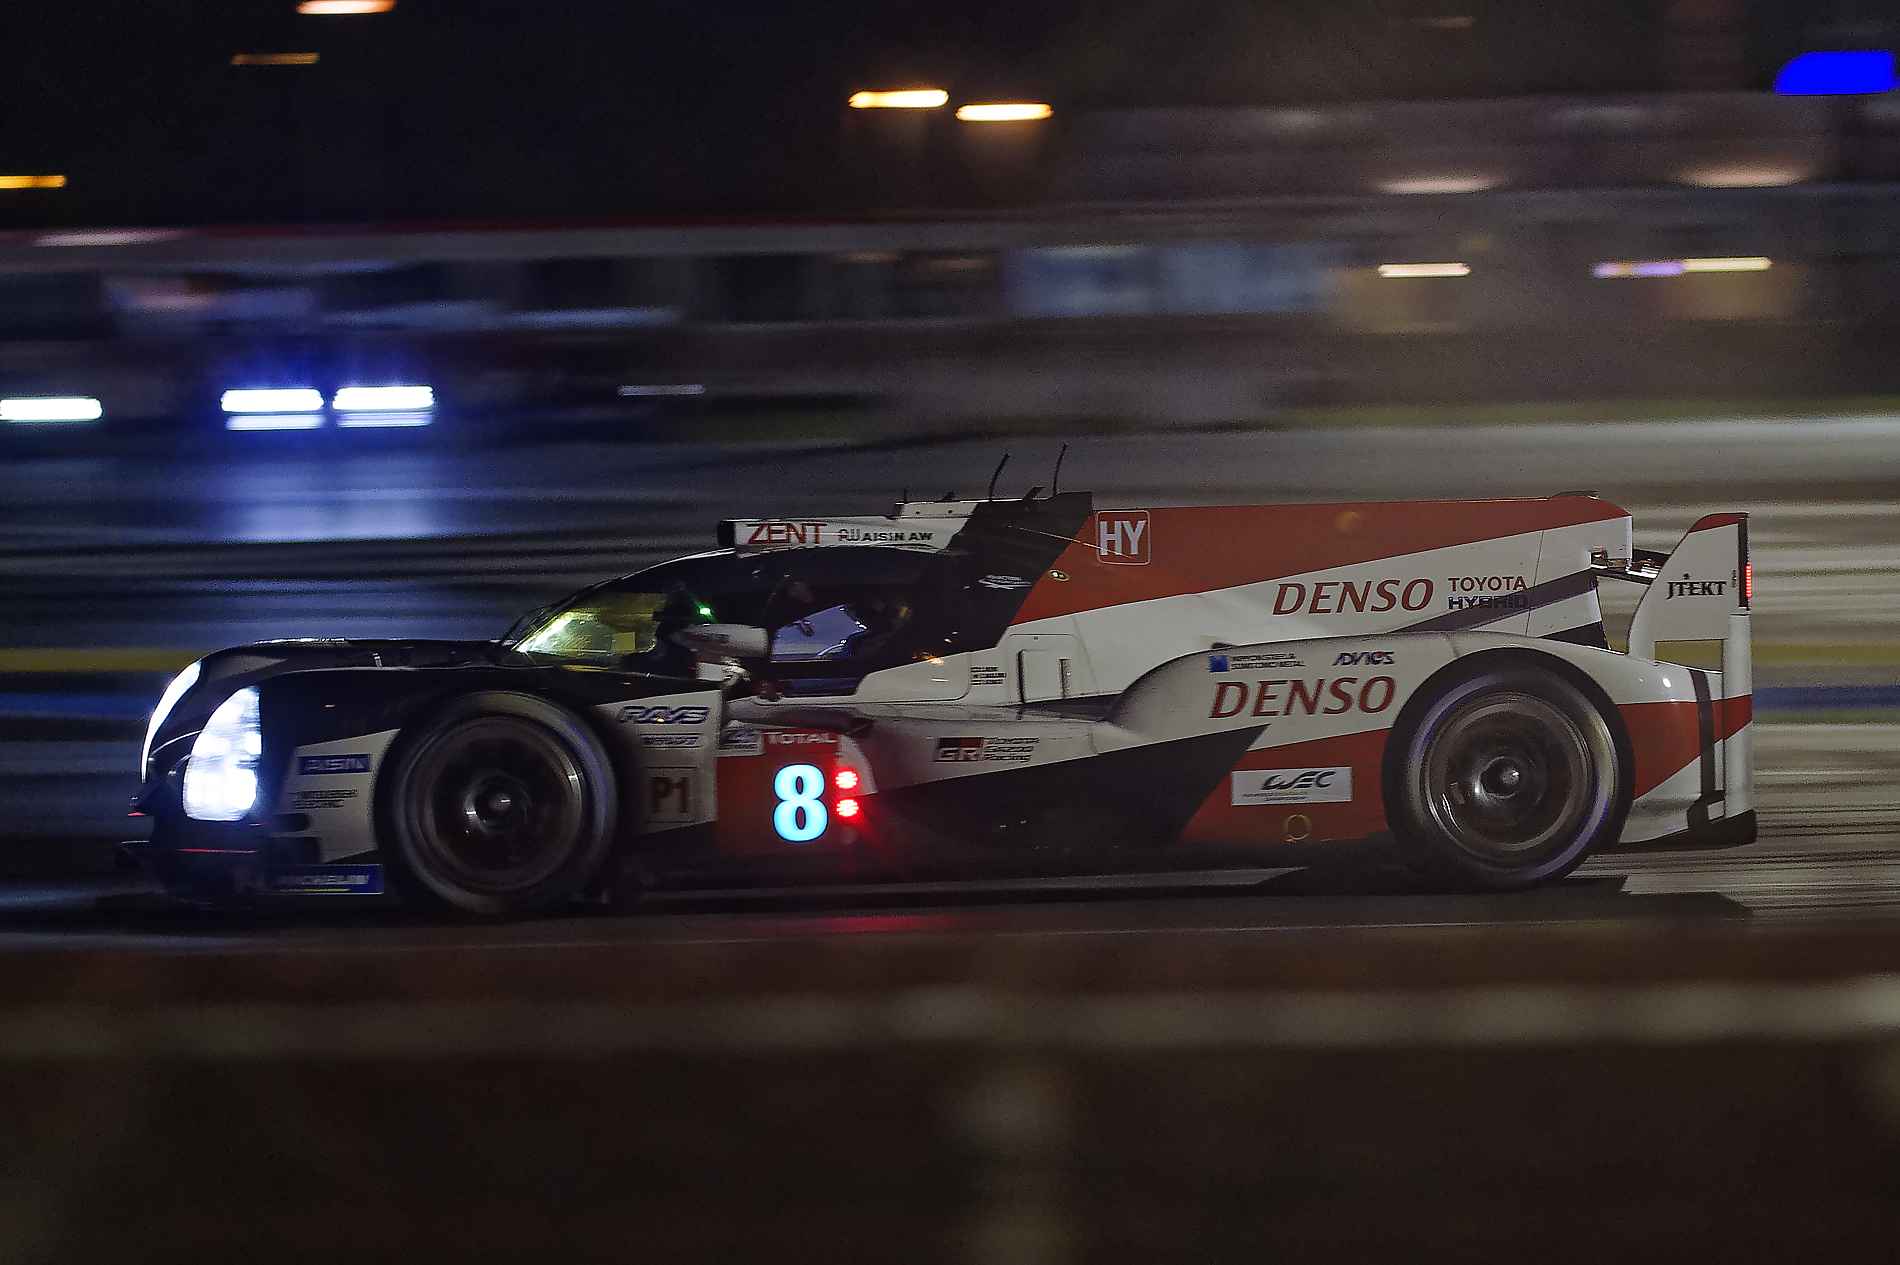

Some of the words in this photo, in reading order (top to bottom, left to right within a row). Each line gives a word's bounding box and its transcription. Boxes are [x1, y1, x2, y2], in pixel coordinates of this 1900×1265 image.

[747, 521, 827, 544] ZENT
[908, 532, 933, 541] AW
[1099, 519, 1147, 556] HY
[1448, 576, 1528, 592] TOYOTA
[1666, 581, 1726, 600] JTEKT
[1272, 578, 1434, 616] DENSO
[1208, 675, 1396, 719] DENSO
[764, 731, 838, 744] TOTAL
[1262, 771, 1337, 790] WEC
[652, 776, 690, 814] P1
[773, 763, 829, 843] 8
